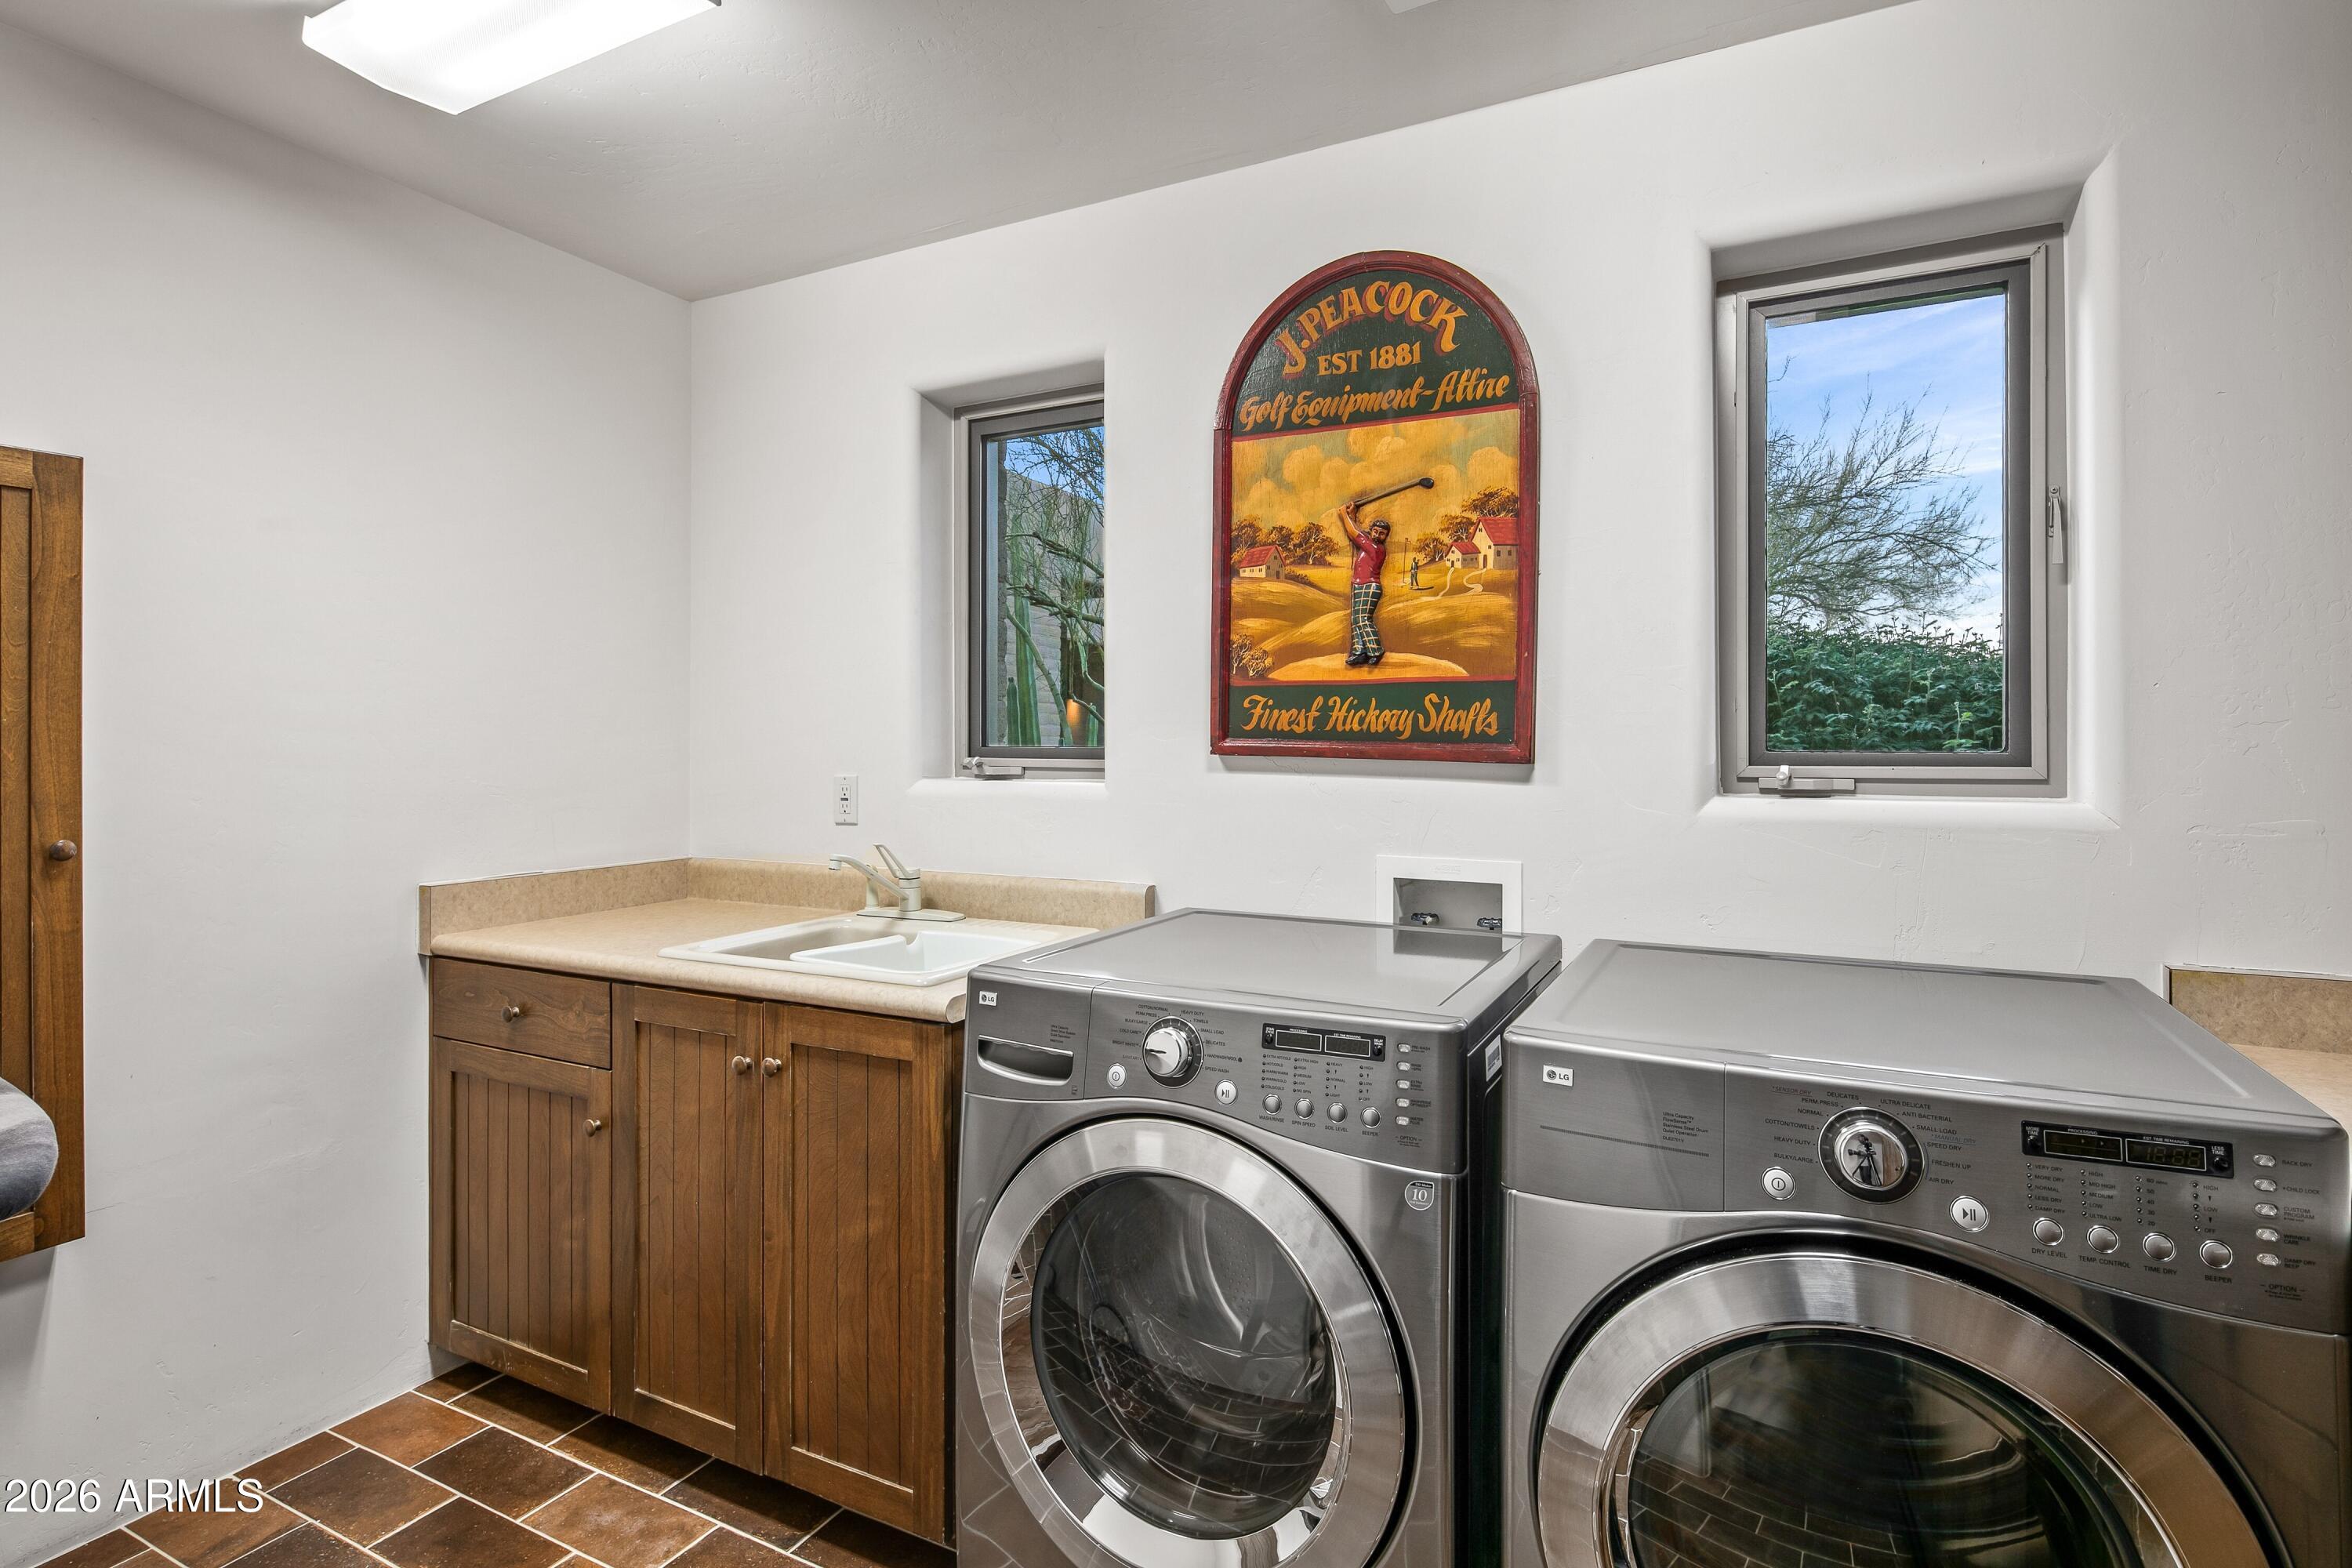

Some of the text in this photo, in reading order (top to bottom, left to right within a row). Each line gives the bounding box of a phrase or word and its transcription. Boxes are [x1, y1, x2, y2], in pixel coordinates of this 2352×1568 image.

[1317, 341, 1422, 376] EST 1881
[1239, 390, 1294, 432] Golf
[1241, 691, 1500, 740] Finest Hickory Shafts
[1827, 1092, 1859, 1100] DELICATES
[1902, 1101, 1931, 1109] DELICATE
[1798, 1108, 1823, 1116] NORMAL
[1918, 1113, 1952, 1122] BACTERIAL
[1765, 1118, 1815, 1130] COTTON/TOWELS
[1774, 1153, 1813, 1163] BULKY/LARGE
[1931, 1159, 1960, 1168] FRESHEN
[1412, 1189, 1427, 1201] 10
[2031, 1247, 2068, 1259] DRY LEVEL
[2098, 1257, 2131, 1268] CONTROL
[2143, 1265, 2177, 1276] TIME DRY
[2204, 1274, 2233, 1284] BEEPER
